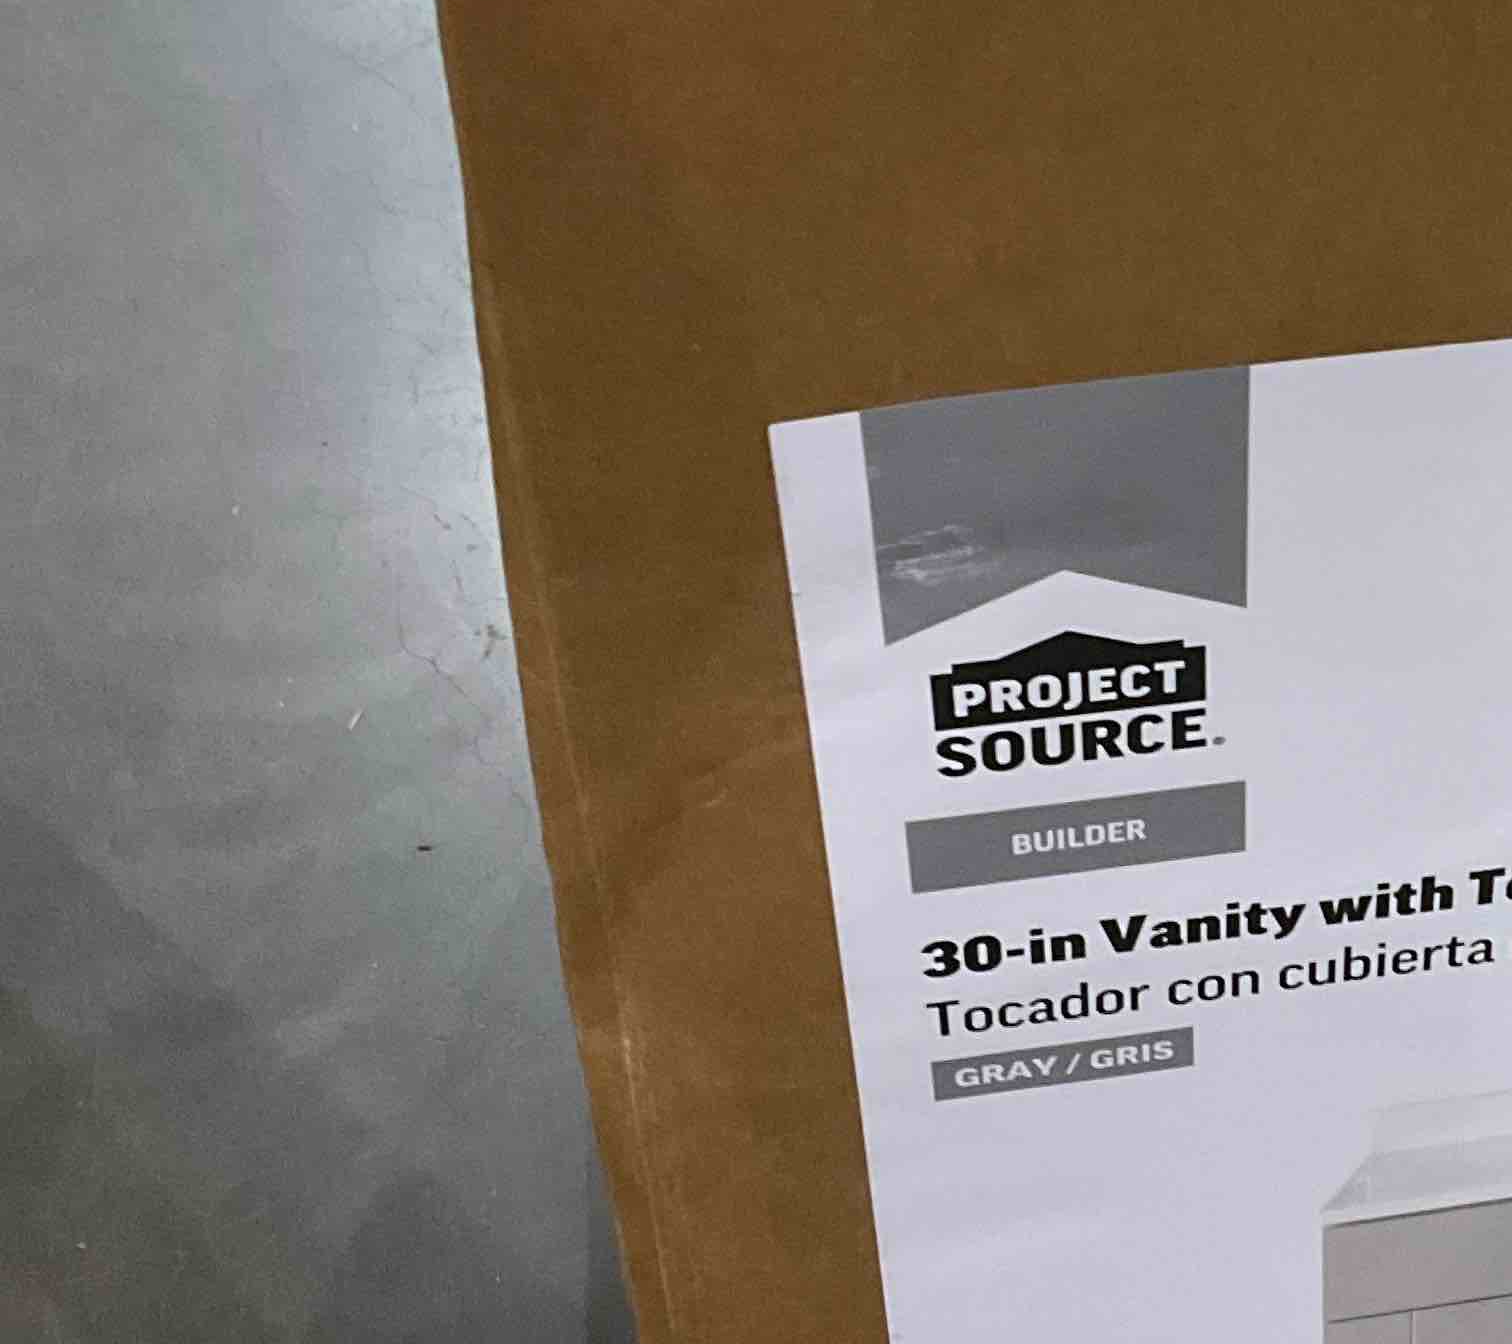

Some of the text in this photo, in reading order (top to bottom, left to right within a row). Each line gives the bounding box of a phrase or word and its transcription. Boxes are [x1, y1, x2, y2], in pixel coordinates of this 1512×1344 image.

[952, 660, 1187, 718] PROJECT
[936, 708, 1207, 777] SOURCE
[1012, 819, 1147, 856] BUILDER
[921, 928, 1086, 978] 30-in
[1100, 902, 1306, 953] Vanity
[1319, 875, 1453, 925] with
[926, 982, 1150, 1036] Tocador
[1168, 968, 1260, 1006] con
[1278, 935, 1494, 989] cubierta
